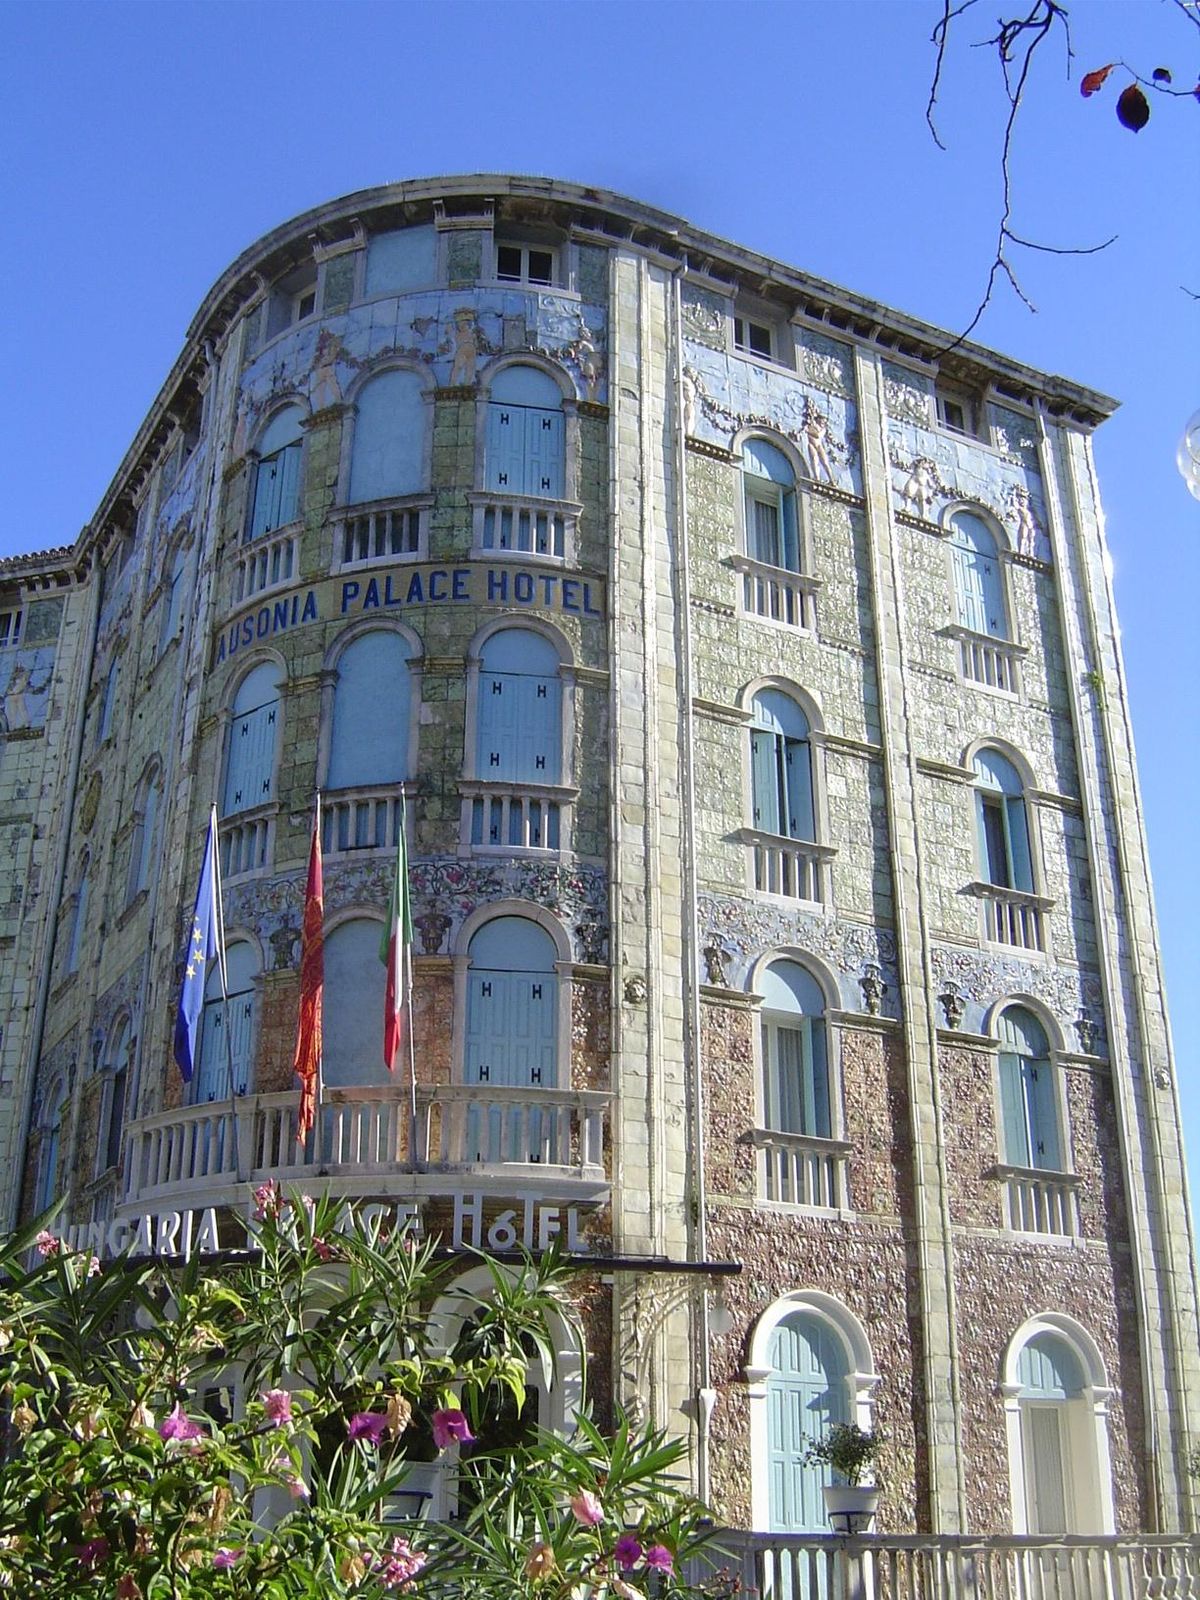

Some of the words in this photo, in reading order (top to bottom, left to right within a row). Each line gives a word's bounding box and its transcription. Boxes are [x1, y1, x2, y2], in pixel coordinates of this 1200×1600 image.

[216, 590, 317, 665] AUSONIA
[341, 569, 471, 613] PALACE
[486, 569, 601, 615] HOTEL
